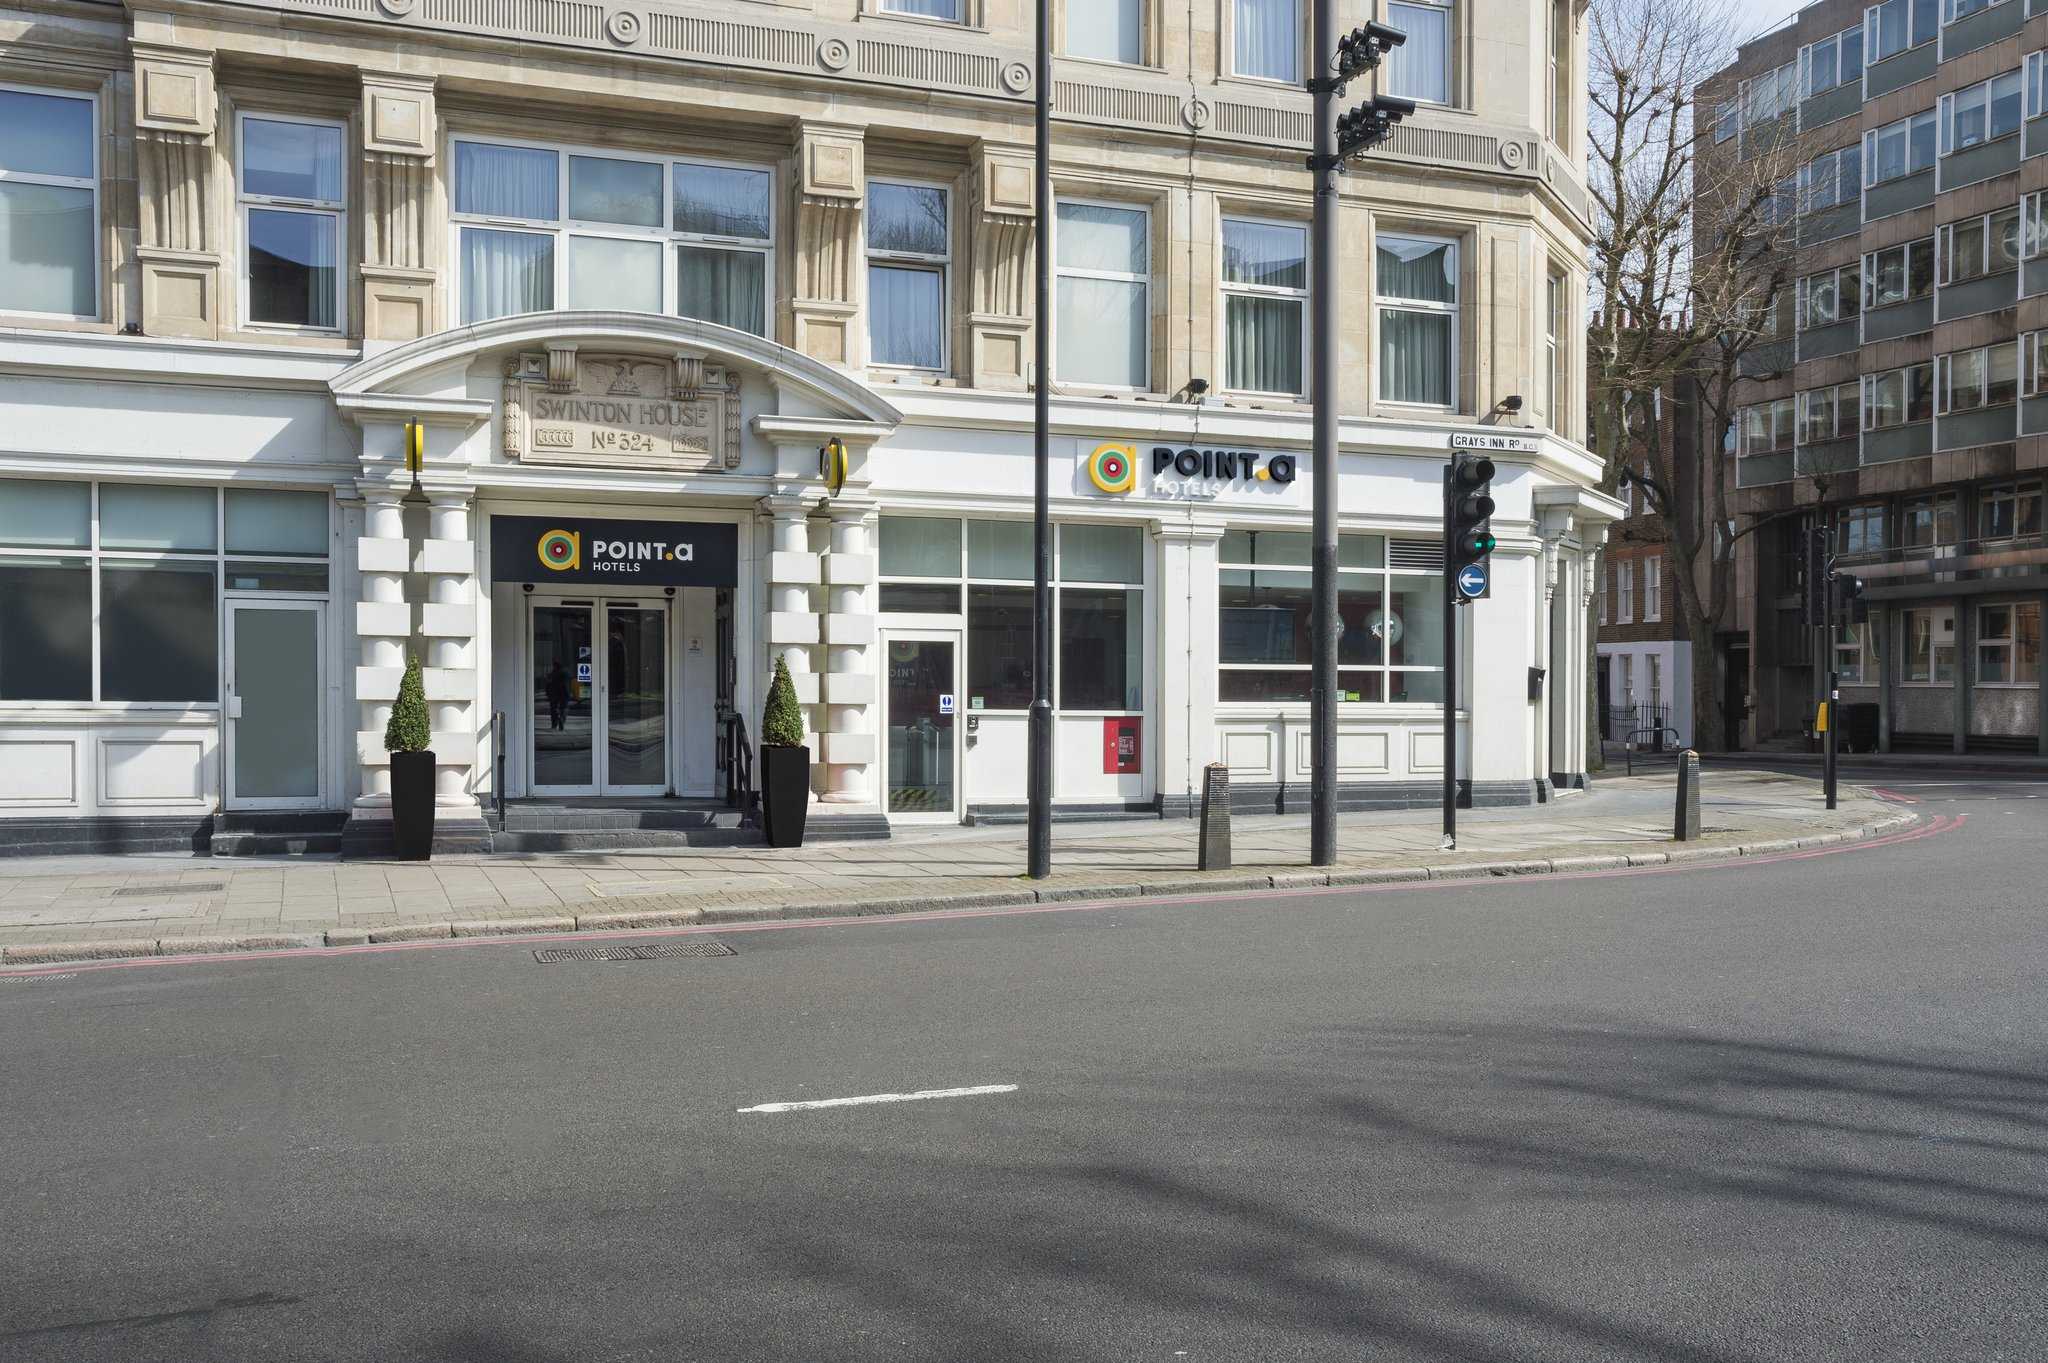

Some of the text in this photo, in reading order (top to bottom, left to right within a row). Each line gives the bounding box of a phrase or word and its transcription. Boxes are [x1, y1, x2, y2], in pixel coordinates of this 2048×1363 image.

[536, 398, 709, 428] SWINTON HOUSE
[619, 431, 654, 452] 324
[1455, 435, 1486, 447] GRAYS
[1489, 437, 1505, 449] INN
[1154, 479, 1223, 497] HOTELS
[593, 561, 641, 572] HOTELS
